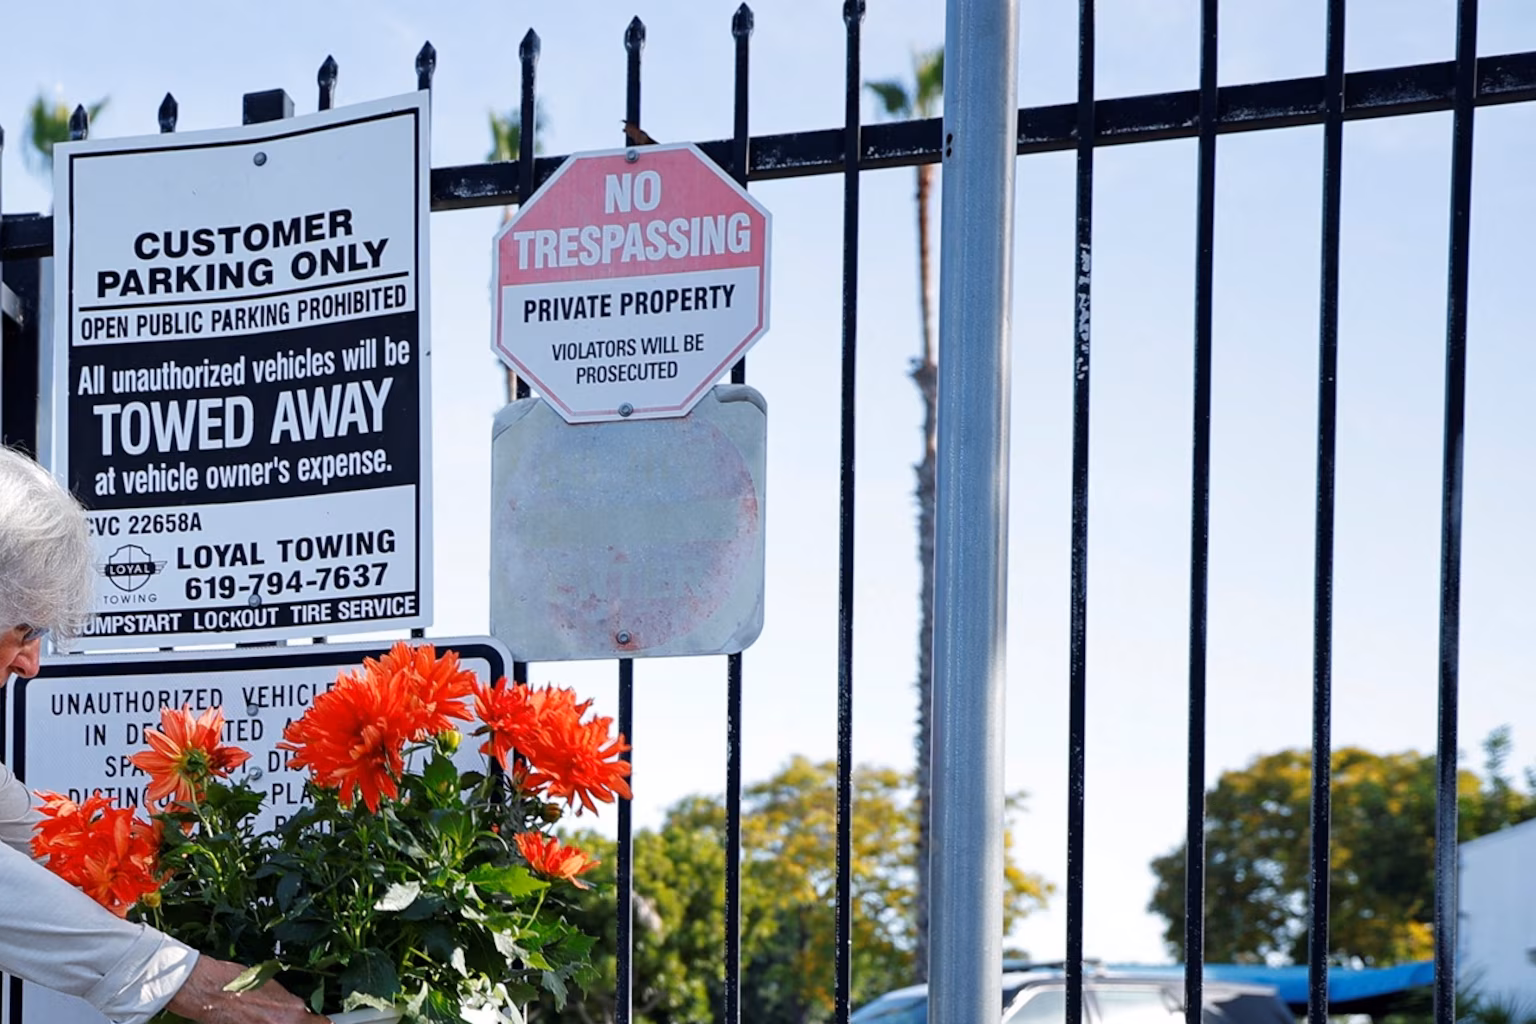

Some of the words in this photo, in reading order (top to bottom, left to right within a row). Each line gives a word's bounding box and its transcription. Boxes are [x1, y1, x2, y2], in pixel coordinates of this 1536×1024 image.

[604, 169, 662, 214] NO
[133, 208, 353, 261] CUSTOMER
[513, 211, 752, 270] TRESPASSING
[97, 260, 274, 298] PARKING
[290, 238, 389, 280] ONLY
[81, 315, 128, 341] OPEN
[136, 311, 203, 337] PUBLIC
[211, 302, 290, 332] PARKING
[297, 284, 407, 322] PROHIBITED
[523, 293, 612, 323] PRIVATE
[619, 284, 736, 316] PROPERTY
[77, 364, 105, 396] All
[112, 355, 246, 394] unauthorized
[252, 347, 336, 384] vehicles
[342, 338, 377, 372] will
[384, 335, 410, 367] be
[551, 338, 637, 361] VIOLATORS
[641, 335, 680, 356] WILL
[683, 333, 705, 352] BE
[576, 361, 679, 385] PROSECUTED
[92, 395, 255, 457] TOWED
[269, 377, 394, 445] AWAY
[94, 466, 116, 496] at
[122, 461, 199, 494] vehicle
[206, 456, 290, 490] owner's
[297, 448, 393, 486] expense.
[128, 512, 202, 535] 22658A
[177, 542, 265, 570] LOYAL
[277, 529, 396, 563] TOWING
[109, 564, 151, 575] LOYAL
[185, 562, 389, 601] 619-794-7637
[103, 593, 158, 605] TOWING
[193, 607, 279, 631] LOCKOUT
[290, 602, 332, 624] TIRE
[338, 595, 416, 620] SERVICE
[51, 688, 223, 715] UNAUTHORIZED
[84, 724, 106, 746] IN
